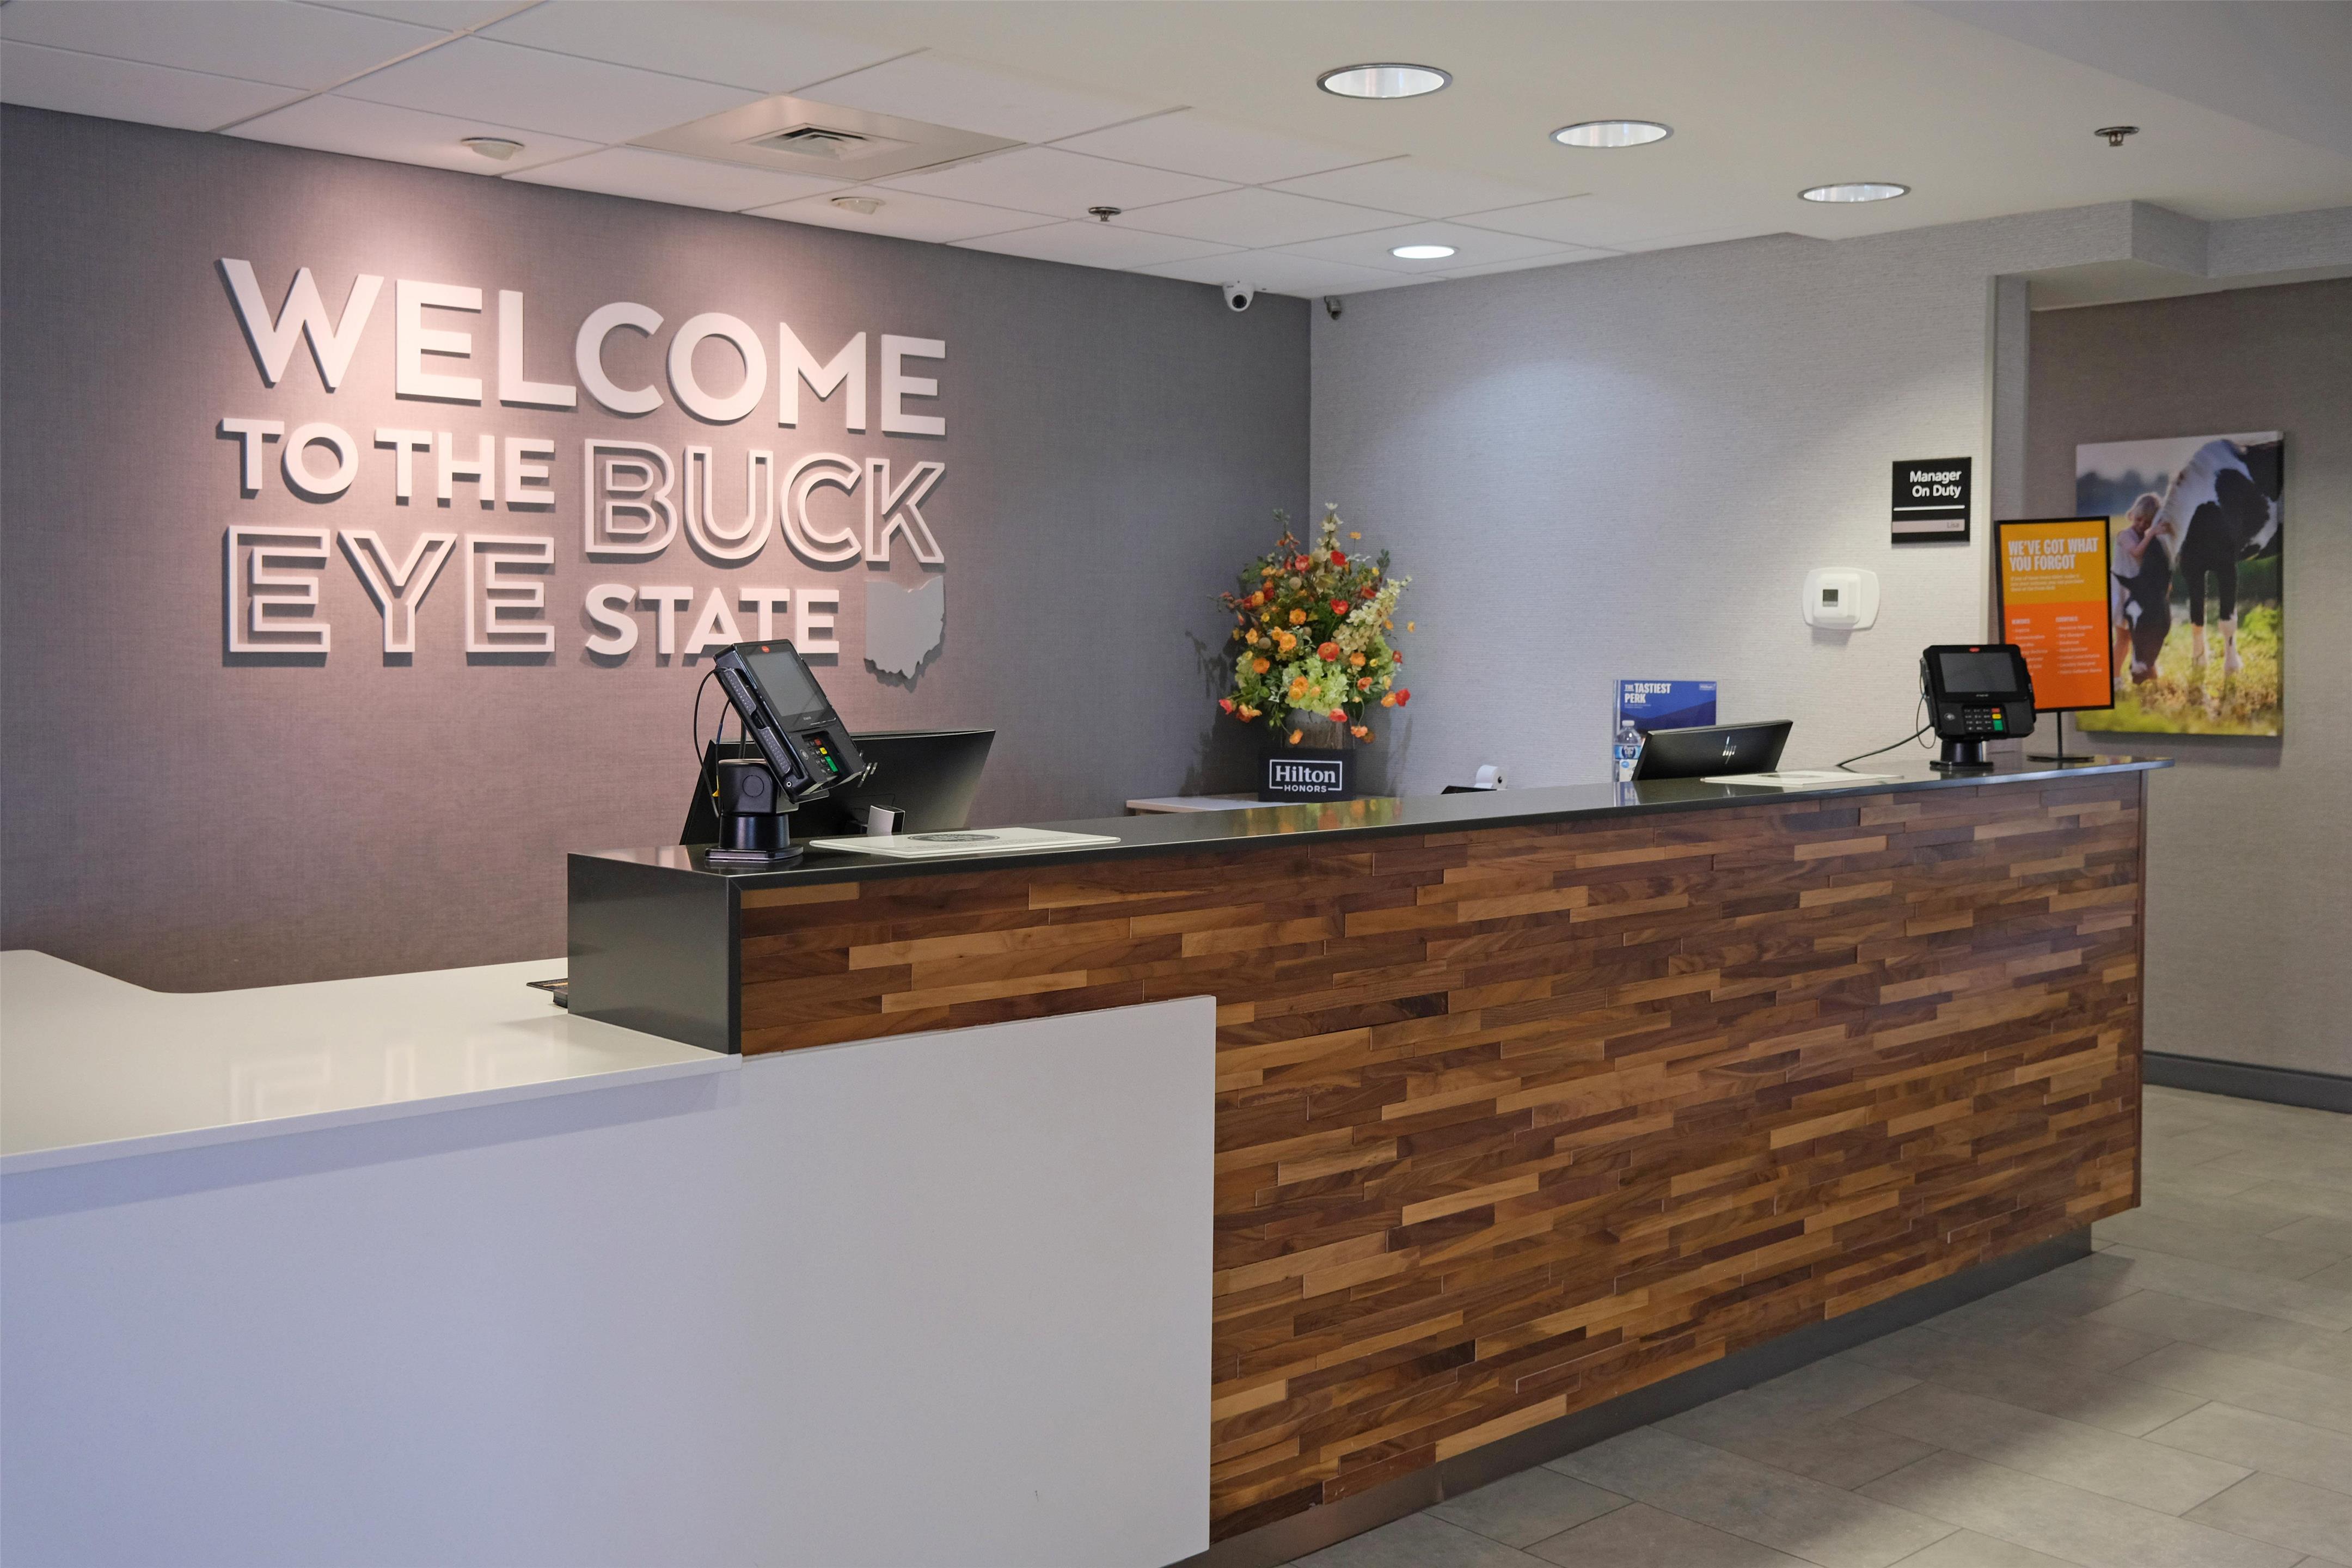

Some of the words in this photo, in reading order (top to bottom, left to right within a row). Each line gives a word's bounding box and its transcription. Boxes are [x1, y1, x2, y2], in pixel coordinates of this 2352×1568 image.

[221, 258, 945, 435] WELCOME
[1909, 470, 1962, 484] Manager
[223, 418, 359, 494] TO
[375, 428, 555, 504] THE
[585, 439, 945, 564] BUCK
[1912, 485, 1930, 498] On
[1933, 485, 1962, 499] Duty
[2008, 540, 2041, 556] WE'VE
[2043, 539, 2065, 554] GOT
[2067, 537, 2099, 553] WHAT
[2009, 556, 2031, 572] YOU
[2034, 554, 2075, 571] FORGOT
[229, 525, 555, 653] EYE
[585, 584, 840, 655] STATE
[1634, 683, 1671, 694] TASTIEST
[1625, 693, 1646, 703] PERK
[1276, 765, 1336, 783] Hilton
[1284, 785, 1327, 793] HONORS
